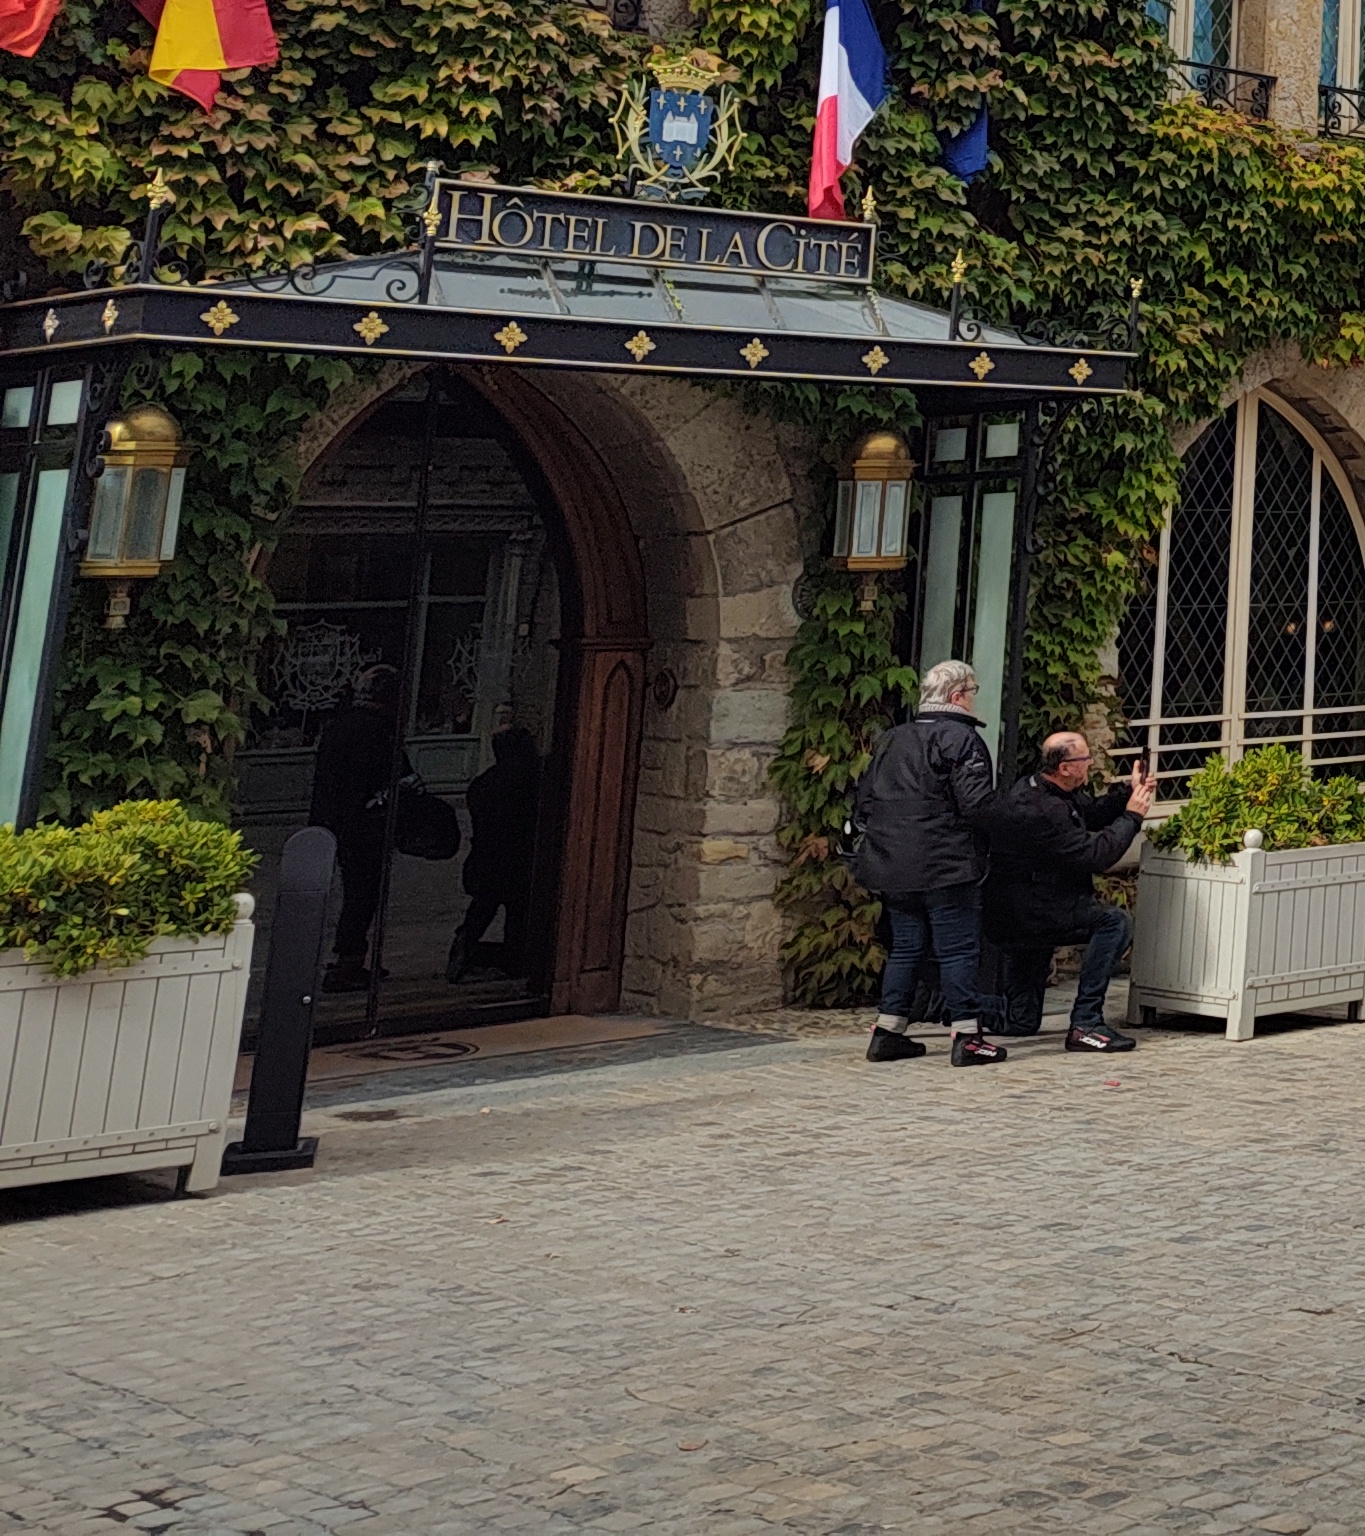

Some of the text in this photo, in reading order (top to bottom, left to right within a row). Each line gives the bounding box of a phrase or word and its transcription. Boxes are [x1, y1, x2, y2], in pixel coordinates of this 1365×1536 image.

[440, 190, 617, 256] HÔTEL
[627, 221, 689, 263] DE
[695, 227, 753, 269] LA
